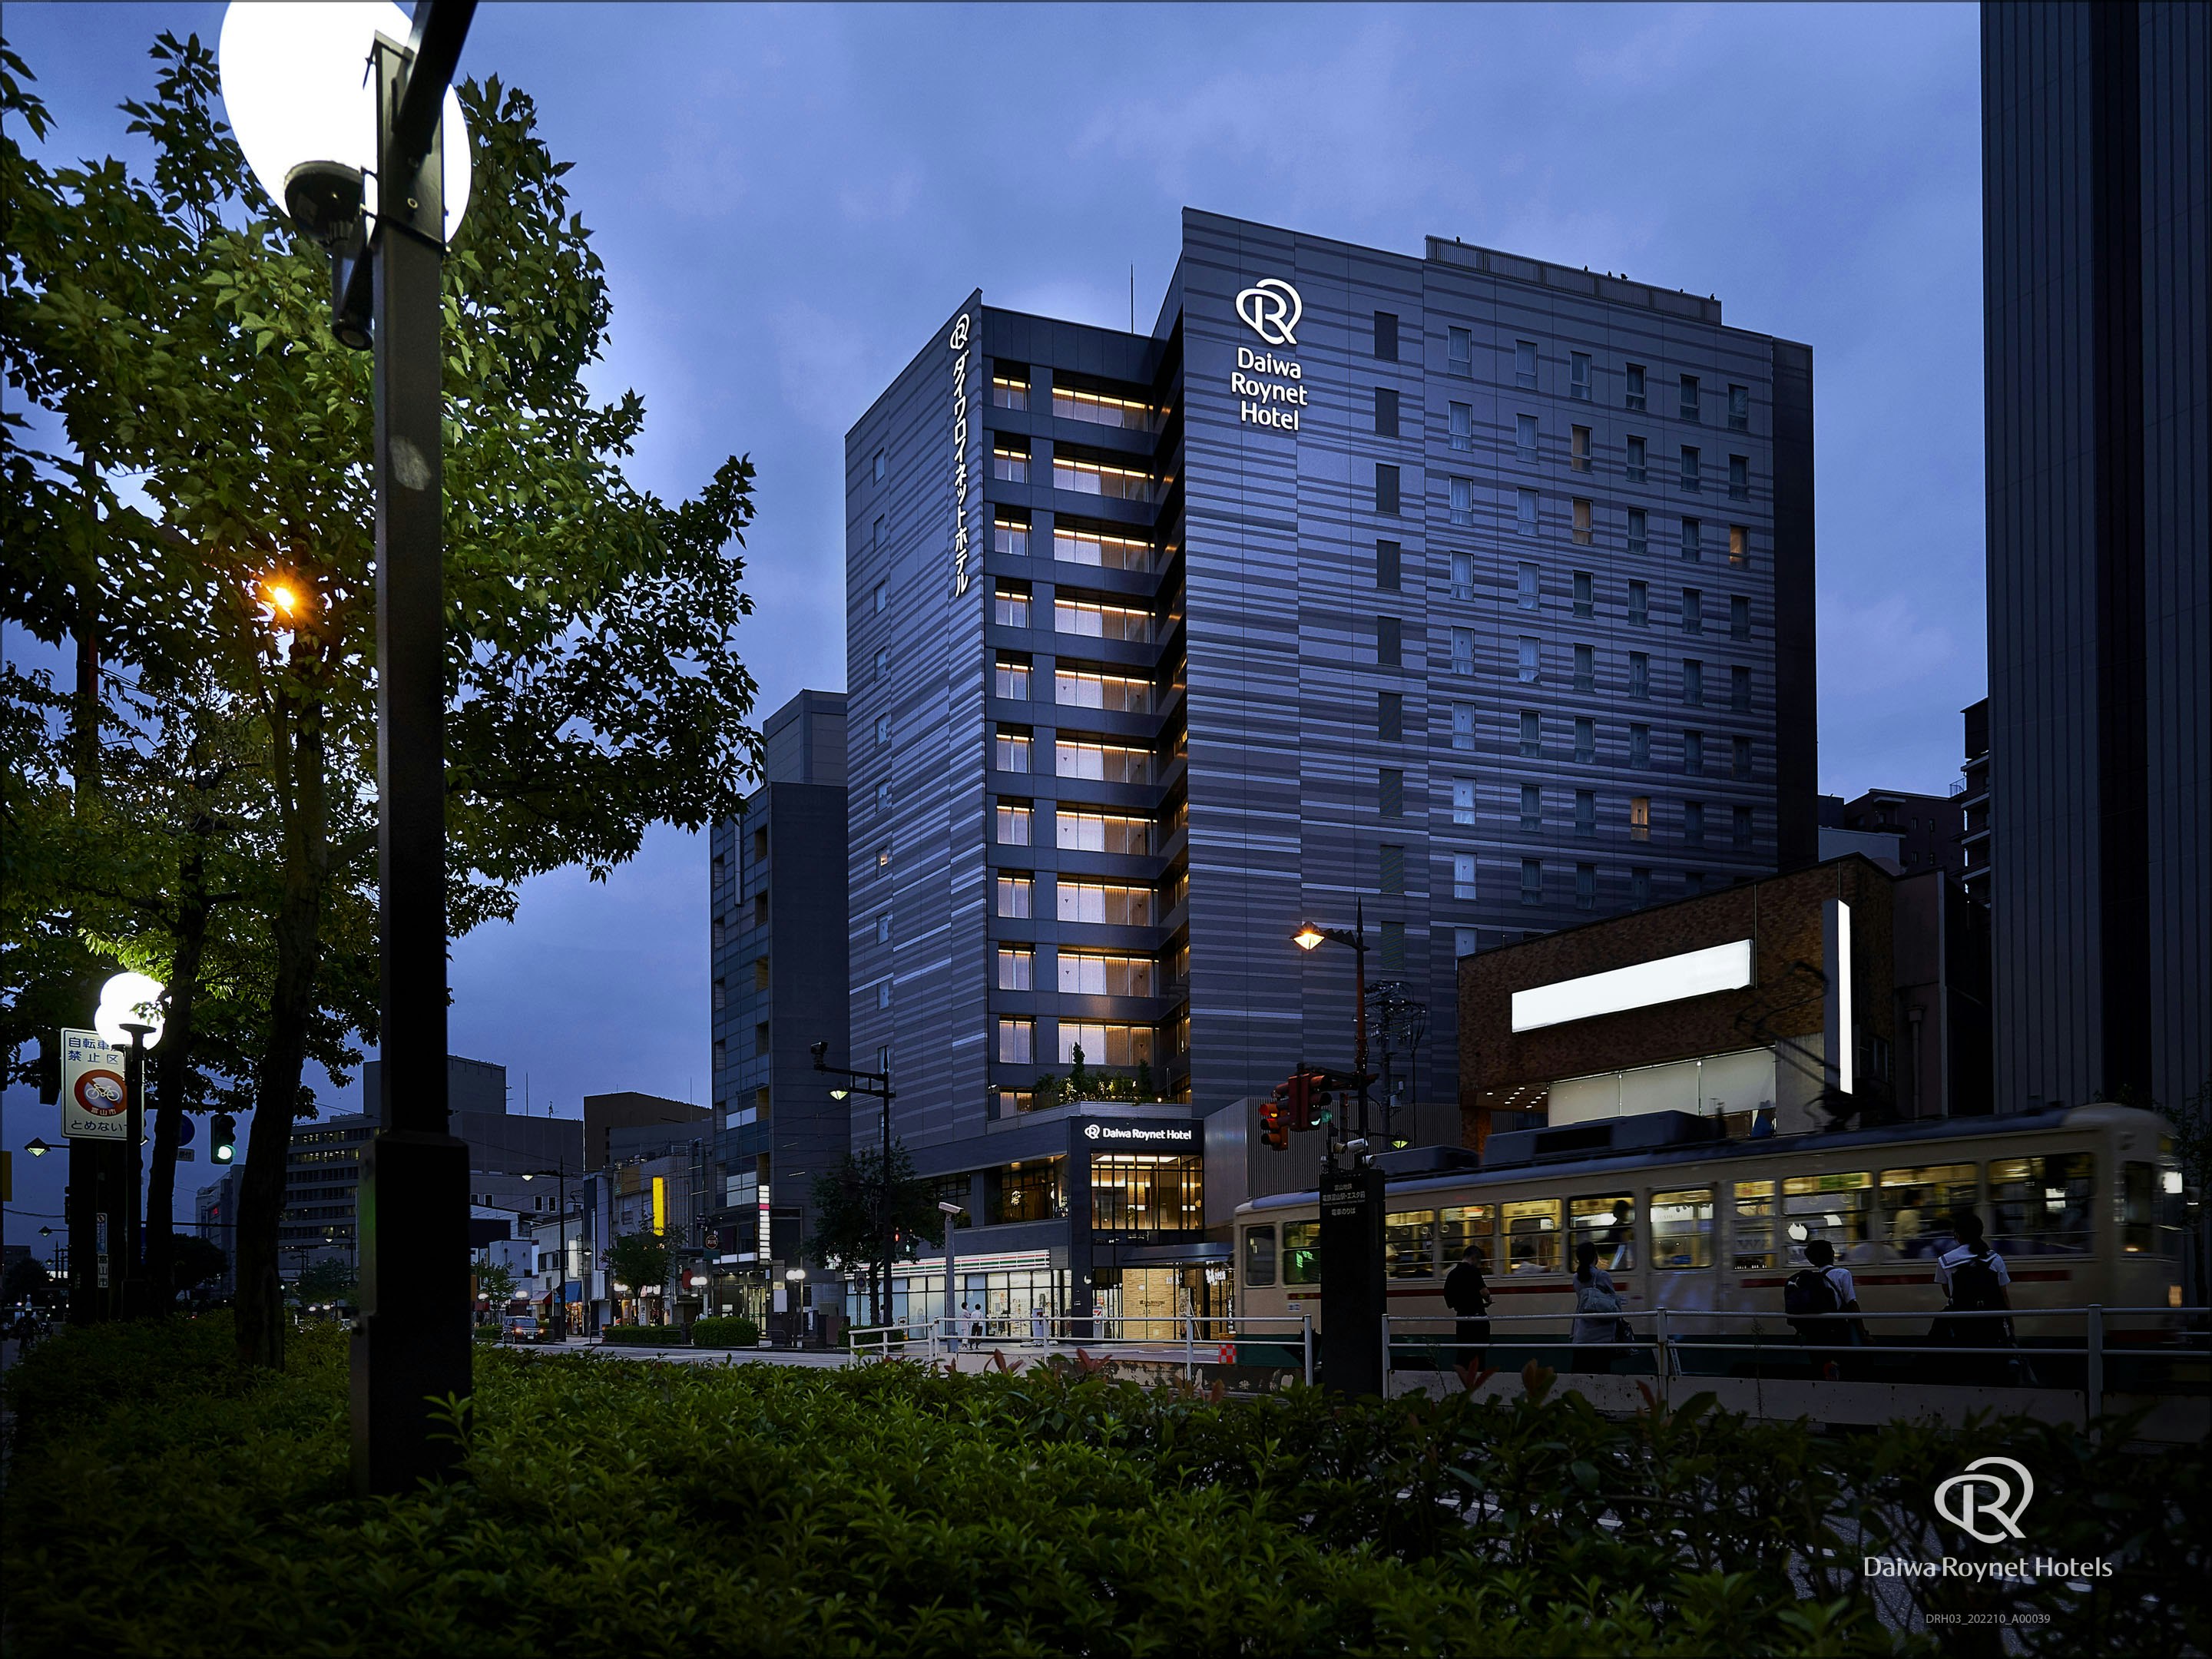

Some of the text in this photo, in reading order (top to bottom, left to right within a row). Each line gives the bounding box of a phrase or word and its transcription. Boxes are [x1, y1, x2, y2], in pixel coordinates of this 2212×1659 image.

[1237, 347, 1302, 379] Daiwa
[1231, 372, 1308, 406] Roynet
[1241, 400, 1300, 431] Hotel
[952, 349, 970, 598] ダイワロイネットホテル
[71, 1120, 127, 1131] とめない
[91, 1107, 117, 1116] 富山市
[1103, 1128, 1192, 1141] Daiwa Roynet Hotel
